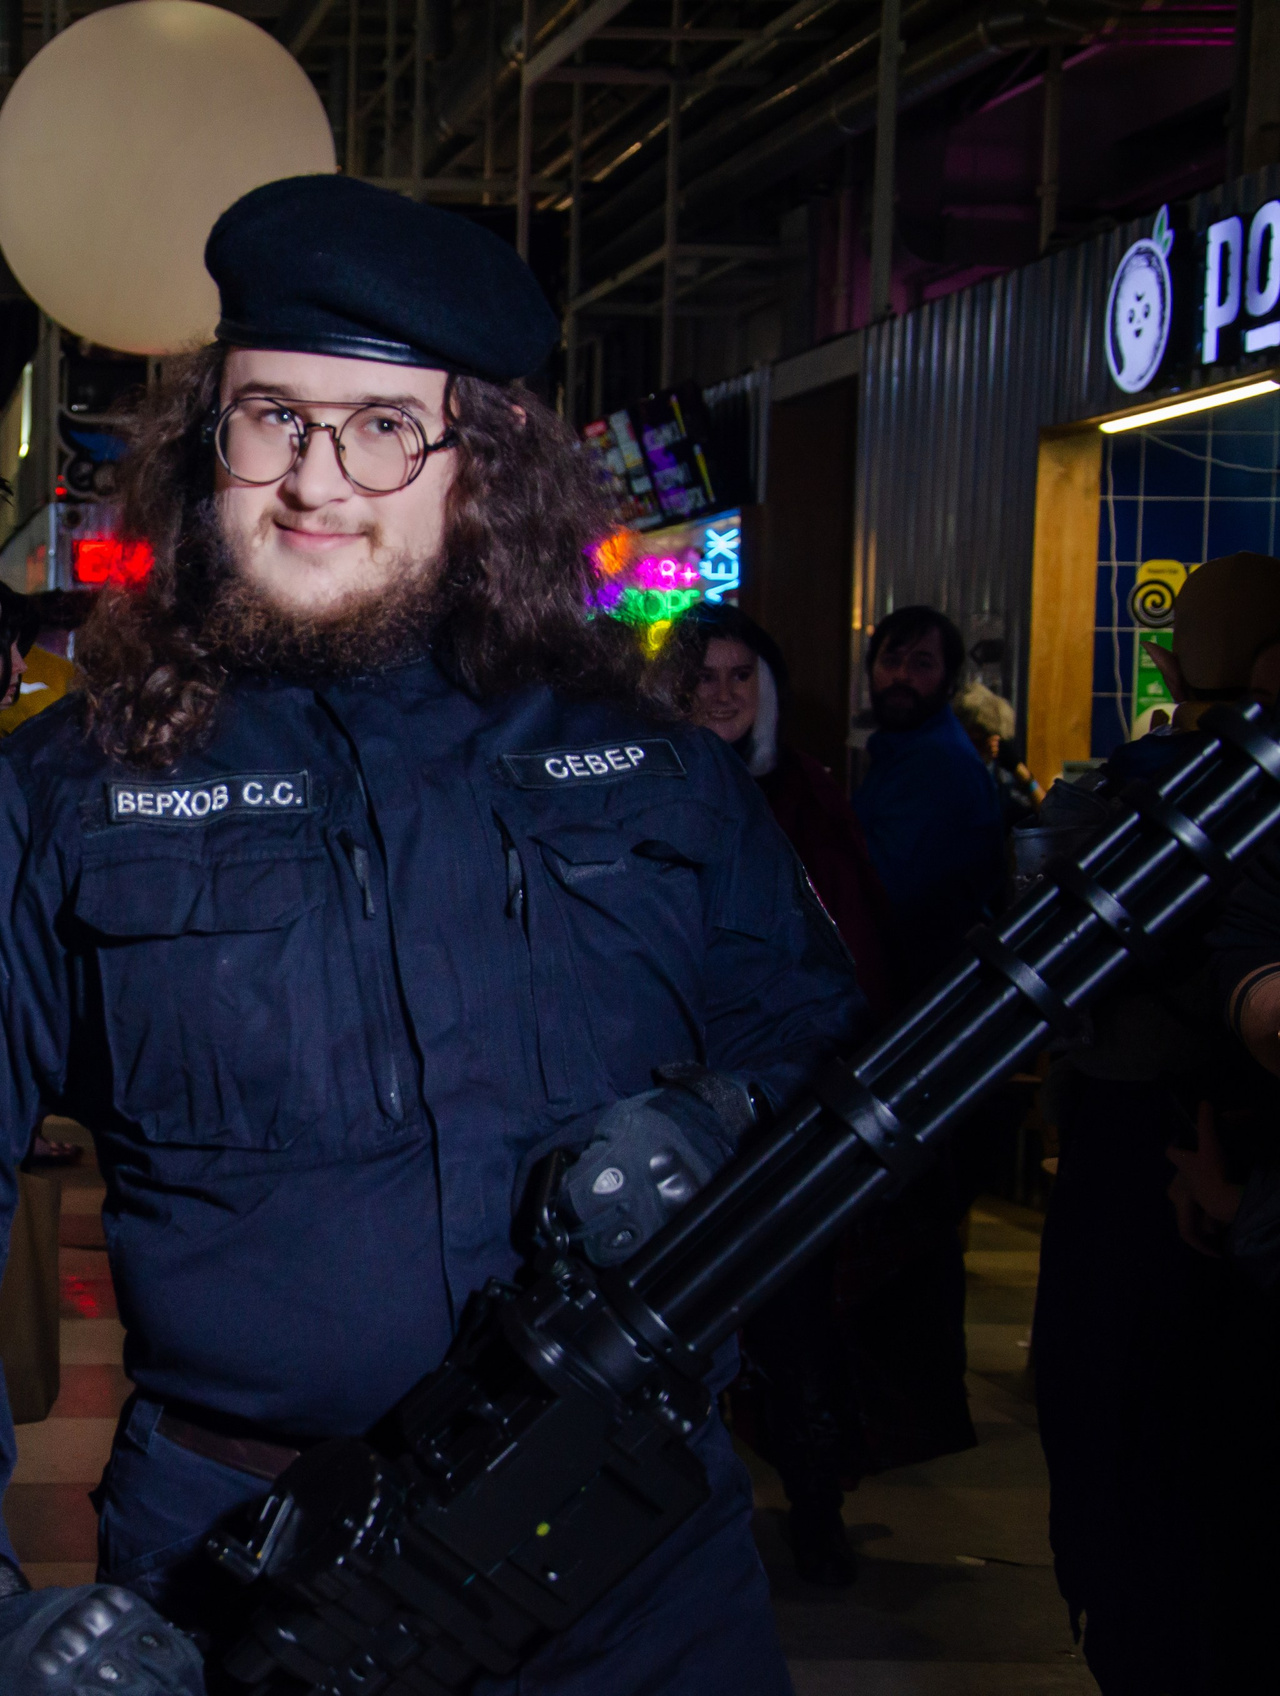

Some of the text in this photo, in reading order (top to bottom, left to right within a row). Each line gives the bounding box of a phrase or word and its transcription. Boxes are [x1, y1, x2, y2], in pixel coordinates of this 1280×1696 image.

[544, 746, 646, 780] СЕВЕР
[117, 781, 303, 817] ВЕРХОВ С.С.
